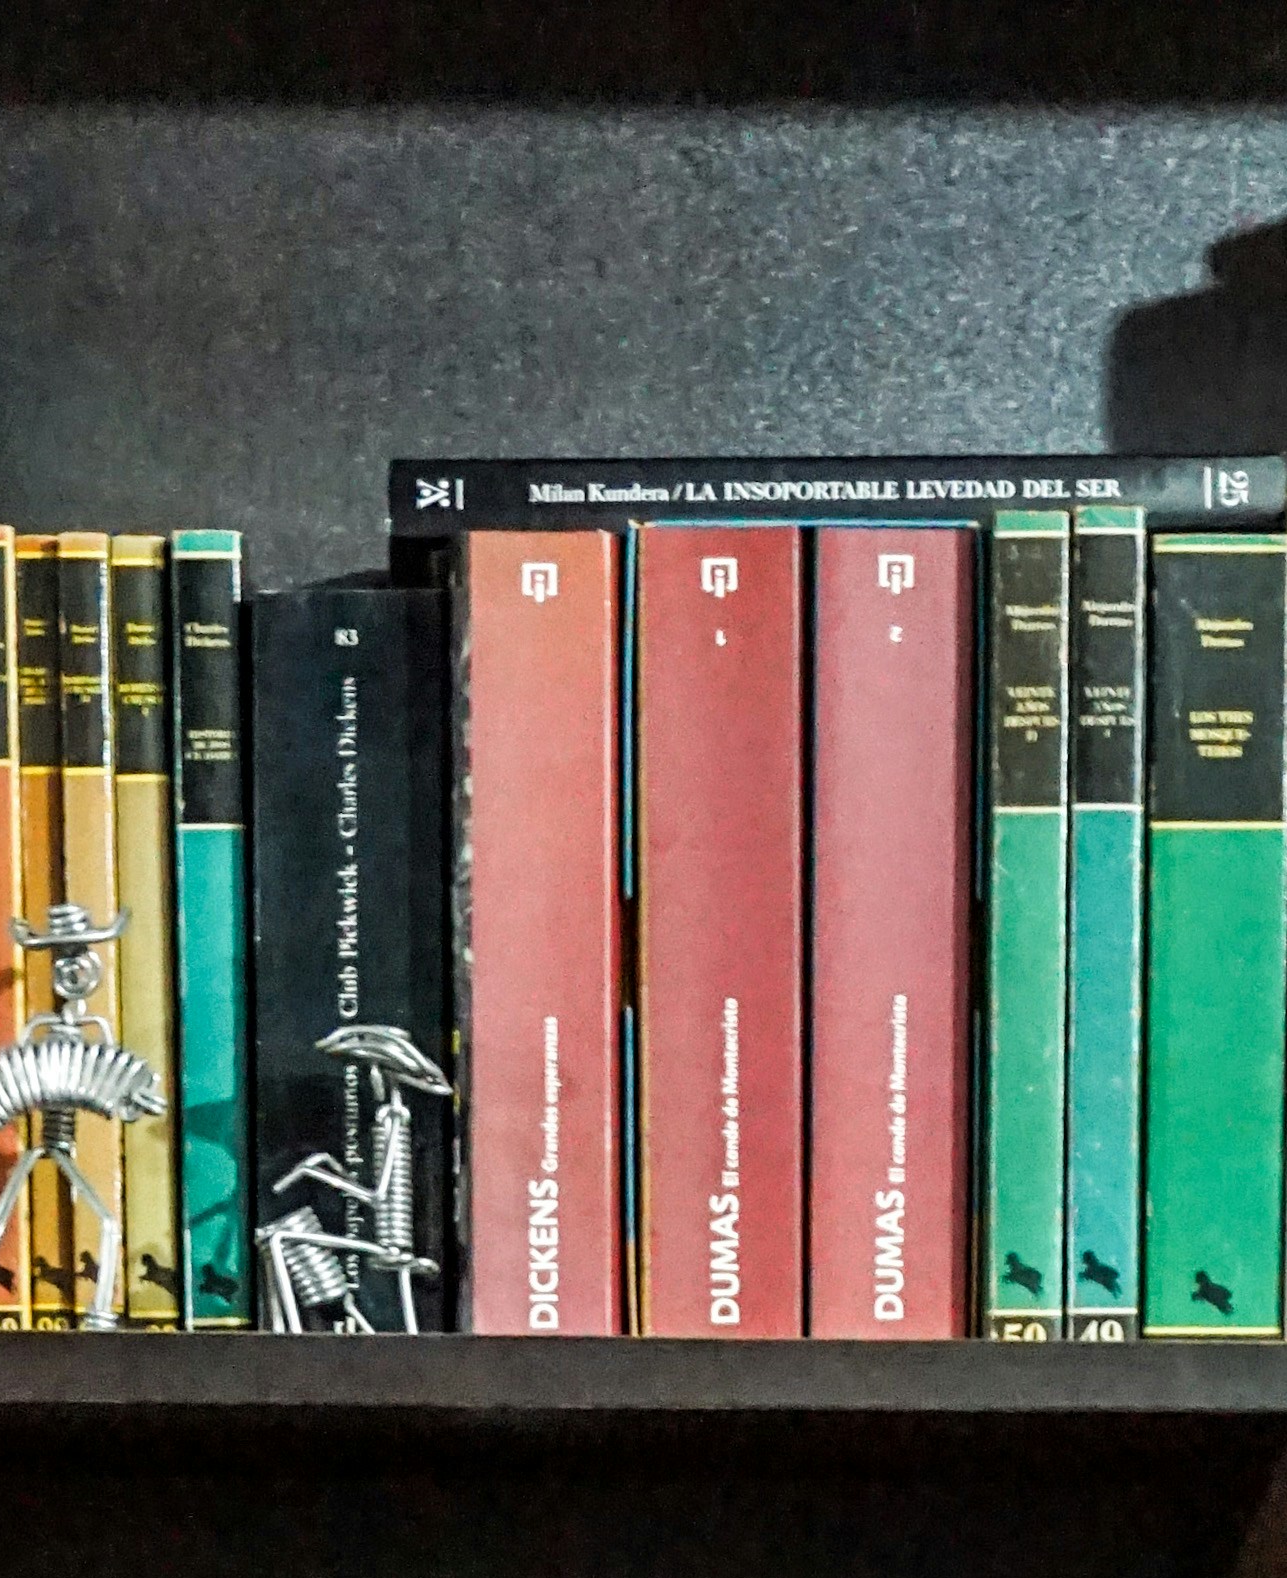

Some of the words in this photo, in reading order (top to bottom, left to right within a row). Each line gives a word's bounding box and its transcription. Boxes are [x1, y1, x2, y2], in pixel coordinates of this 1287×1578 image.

[528, 483, 585, 503] Milan
[589, 483, 670, 502] Kundera
[683, 483, 713, 501] LA
[722, 482, 899, 501] INSOPORTABLE
[905, 480, 1014, 499] LEVEDAD
[1022, 479, 1070, 499] DEL
[1076, 478, 1121, 498] SER
[525, 1170, 564, 1334] DICKENS
[704, 1190, 745, 1330] DUMAS
[869, 1185, 909, 1326] DUMAS
